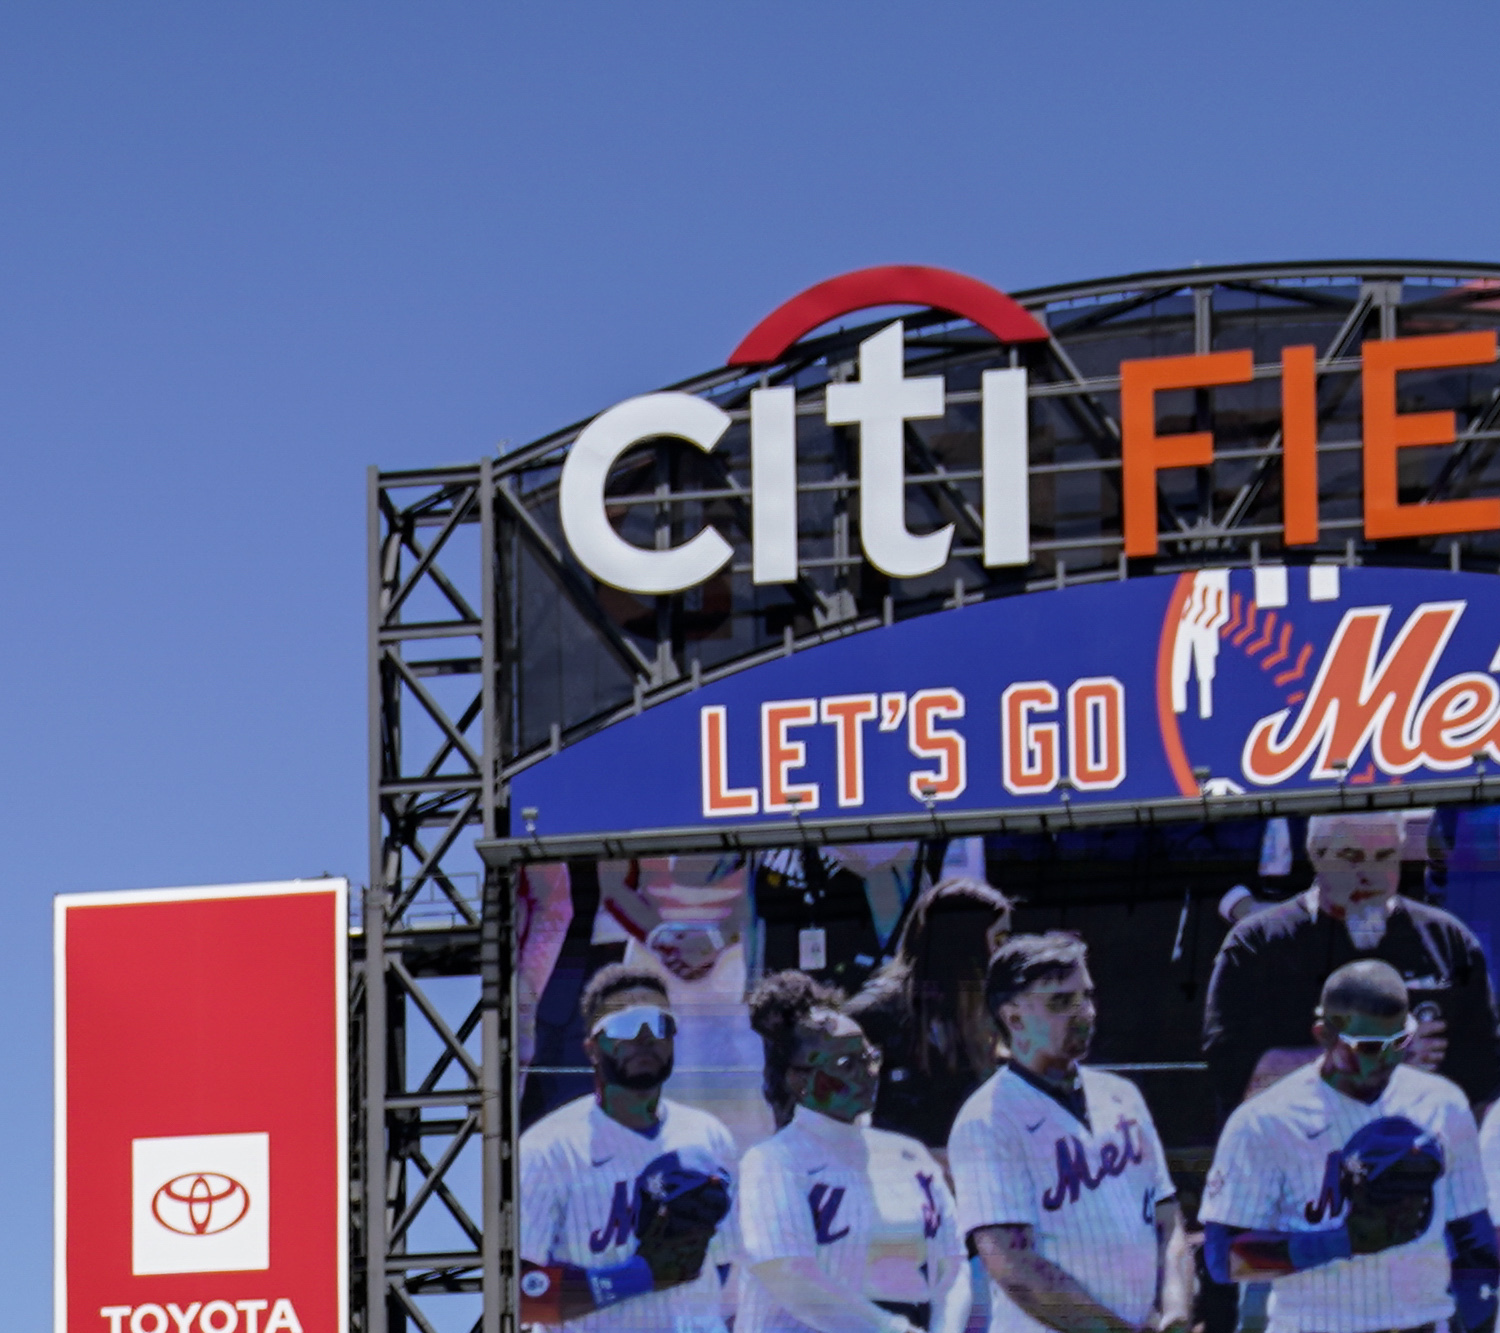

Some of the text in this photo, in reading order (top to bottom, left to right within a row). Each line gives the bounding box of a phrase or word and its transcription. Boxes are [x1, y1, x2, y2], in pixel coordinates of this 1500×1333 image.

[559, 318, 1032, 594] citi
[699, 675, 1126, 819] LET'S GO
